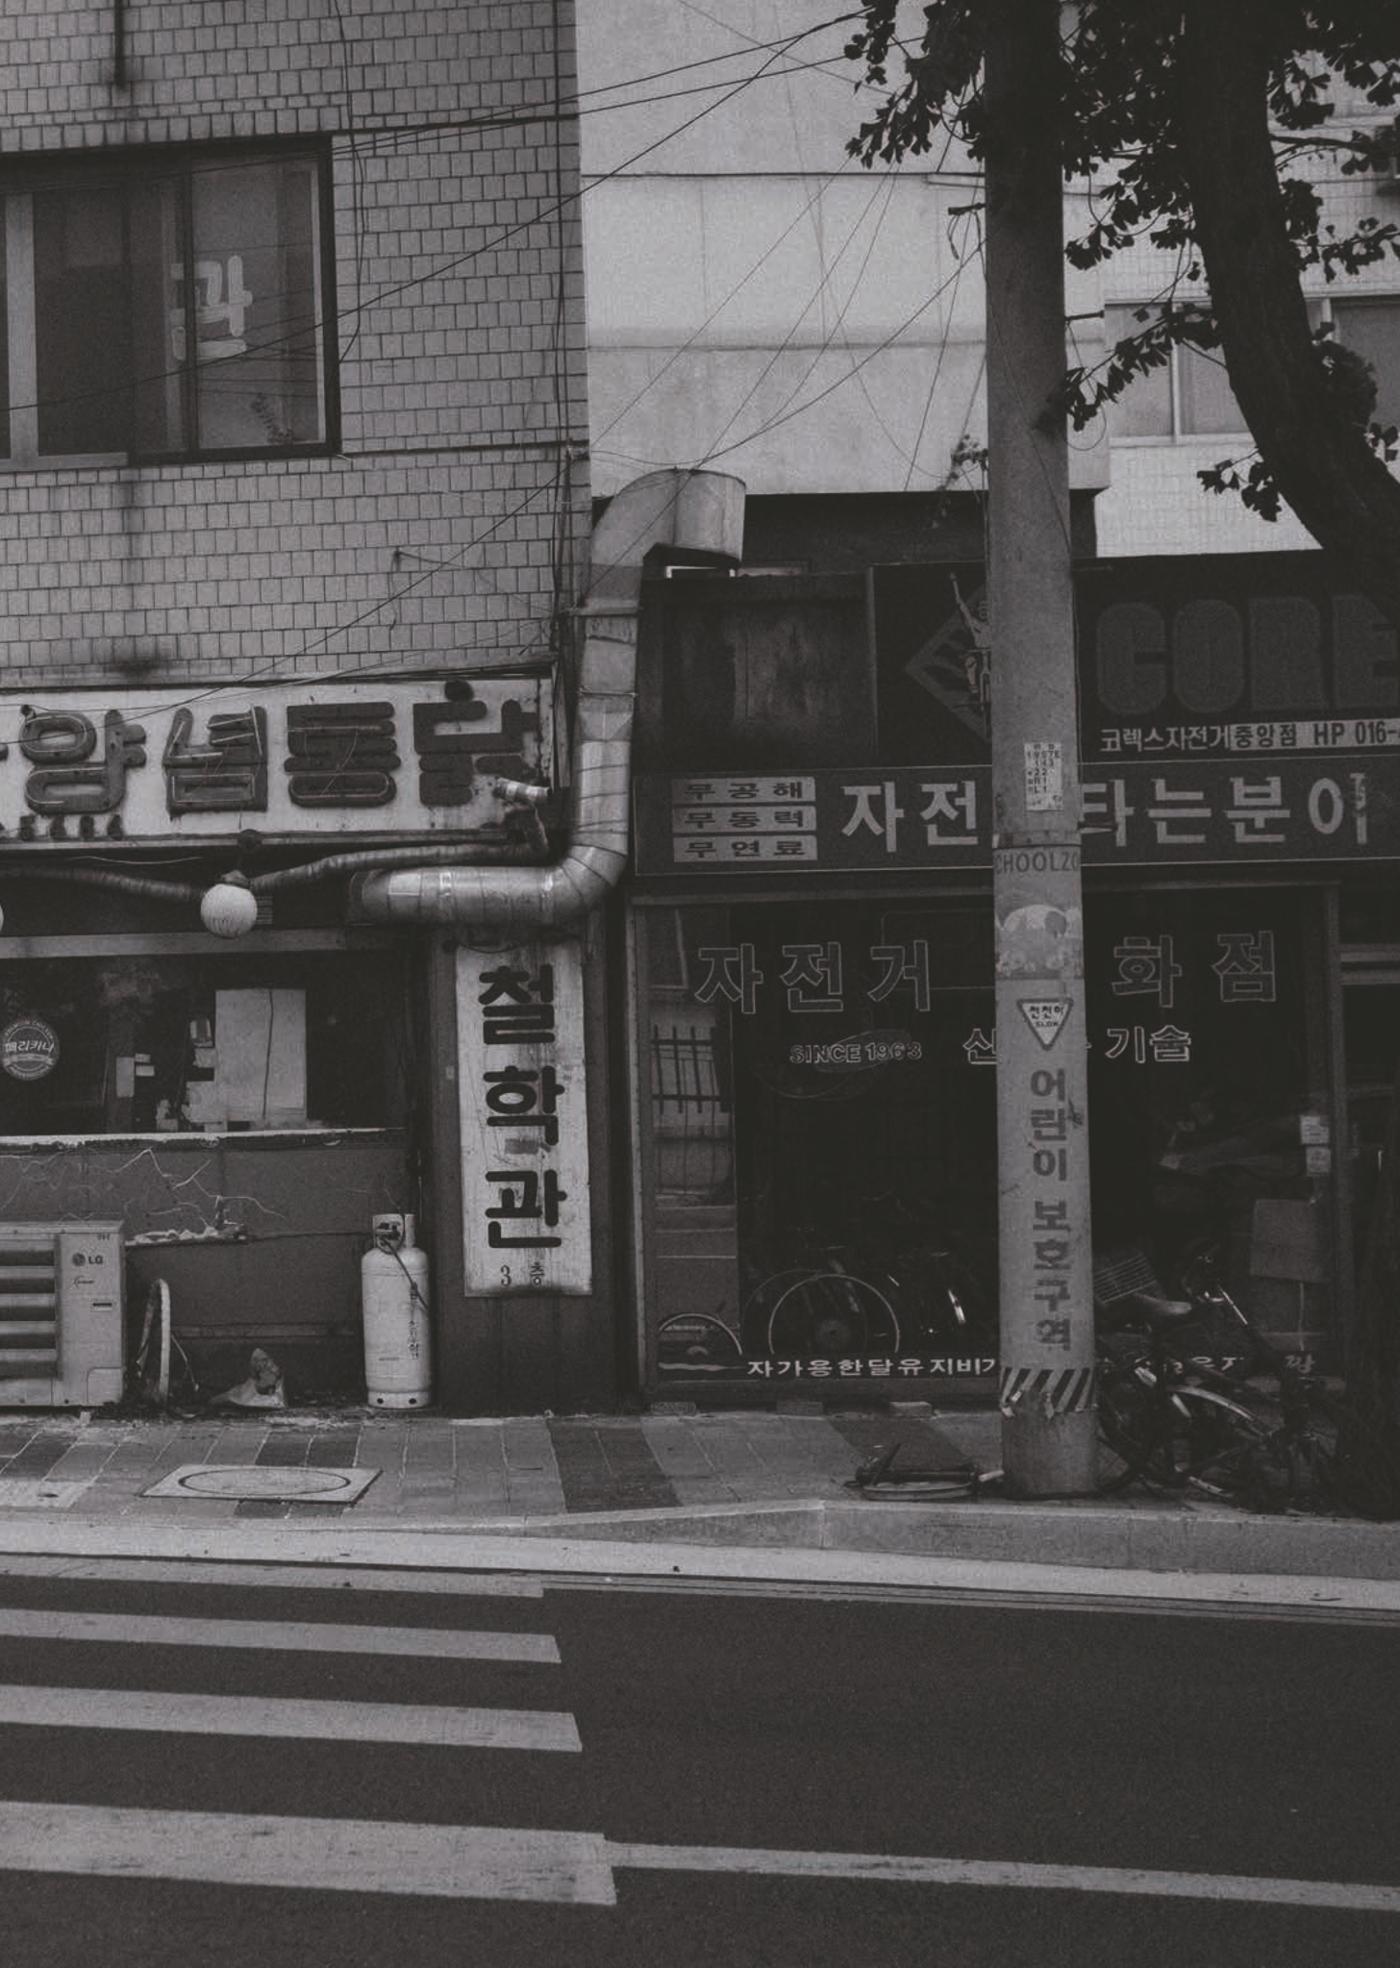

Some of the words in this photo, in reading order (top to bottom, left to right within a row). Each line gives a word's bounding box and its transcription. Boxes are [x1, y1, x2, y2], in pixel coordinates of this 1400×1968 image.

[1099, 724, 1231, 752] 코렉스자전거
[1233, 723, 1297, 749] 중앙점
[1313, 722, 1345, 746] HP
[1355, 718, 1400, 744] 016-
[685, 783, 802, 801] 무공해
[685, 811, 804, 829] 무동력
[685, 840, 805, 859] 무연료
[694, 939, 931, 1014] 자전거
[789, 1042, 862, 1064] SINCE
[1105, 1024, 1193, 1064] 기술
[479, 964, 566, 1249] 철학관
[1029, 1067, 1068, 1182] 어린이
[88, 1255, 104, 1265] LG
